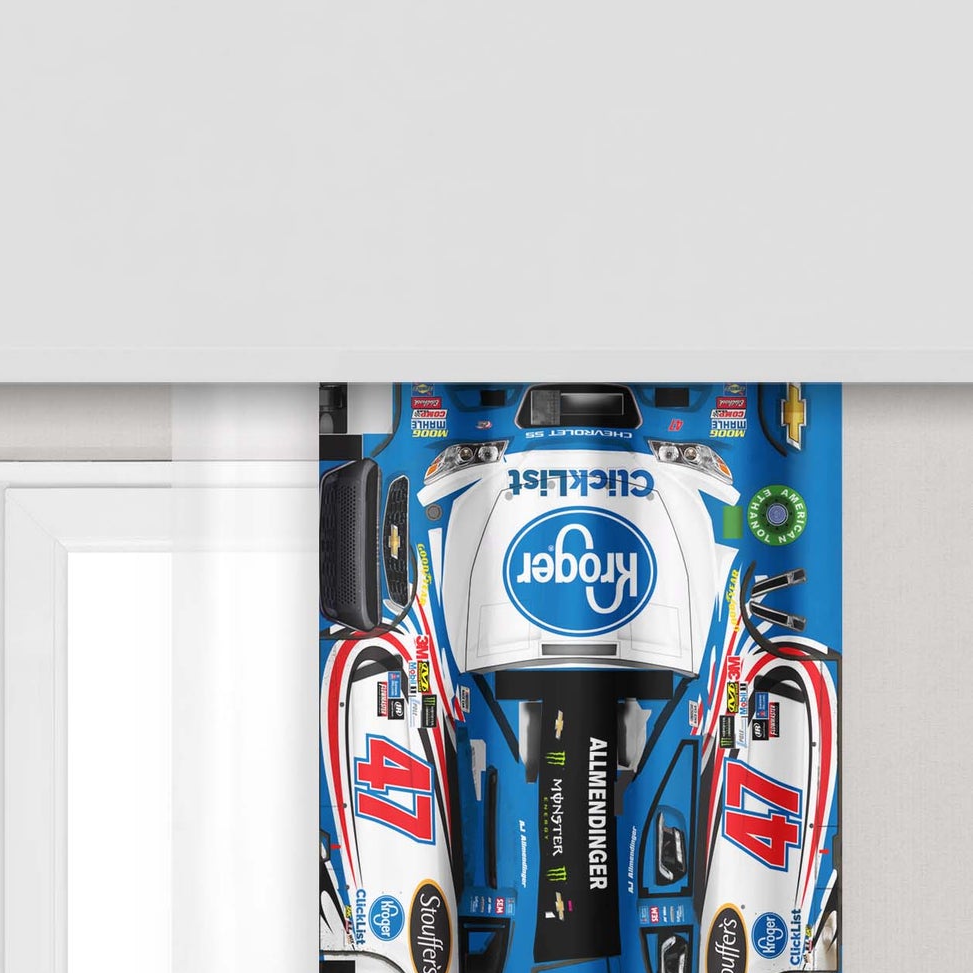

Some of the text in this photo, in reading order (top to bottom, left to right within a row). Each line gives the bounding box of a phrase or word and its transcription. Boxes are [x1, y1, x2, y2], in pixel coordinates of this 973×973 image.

[412, 421, 445, 429] MAHLE
[412, 429, 448, 437] MOOG
[525, 430, 632, 439] CHEVROLET SS
[668, 419, 683, 432] 47
[712, 421, 745, 429] MAHLE
[507, 469, 654, 497] ClickList
[750, 489, 805, 543] AMERICAN ETHANOL
[517, 523, 637, 614] Kroger
[416, 635, 428, 659] 3M
[728, 657, 740, 680] 3M
[354, 733, 435, 845] 47
[550, 779, 564, 857] MONSTER
[588, 737, 607, 890] ALLMENDINGER
[721, 757, 802, 872] 47
[356, 889, 366, 945] ClickList
[372, 900, 398, 938] Kroger
[759, 916, 783, 953] Kroger
[789, 909, 802, 965] ClickList
